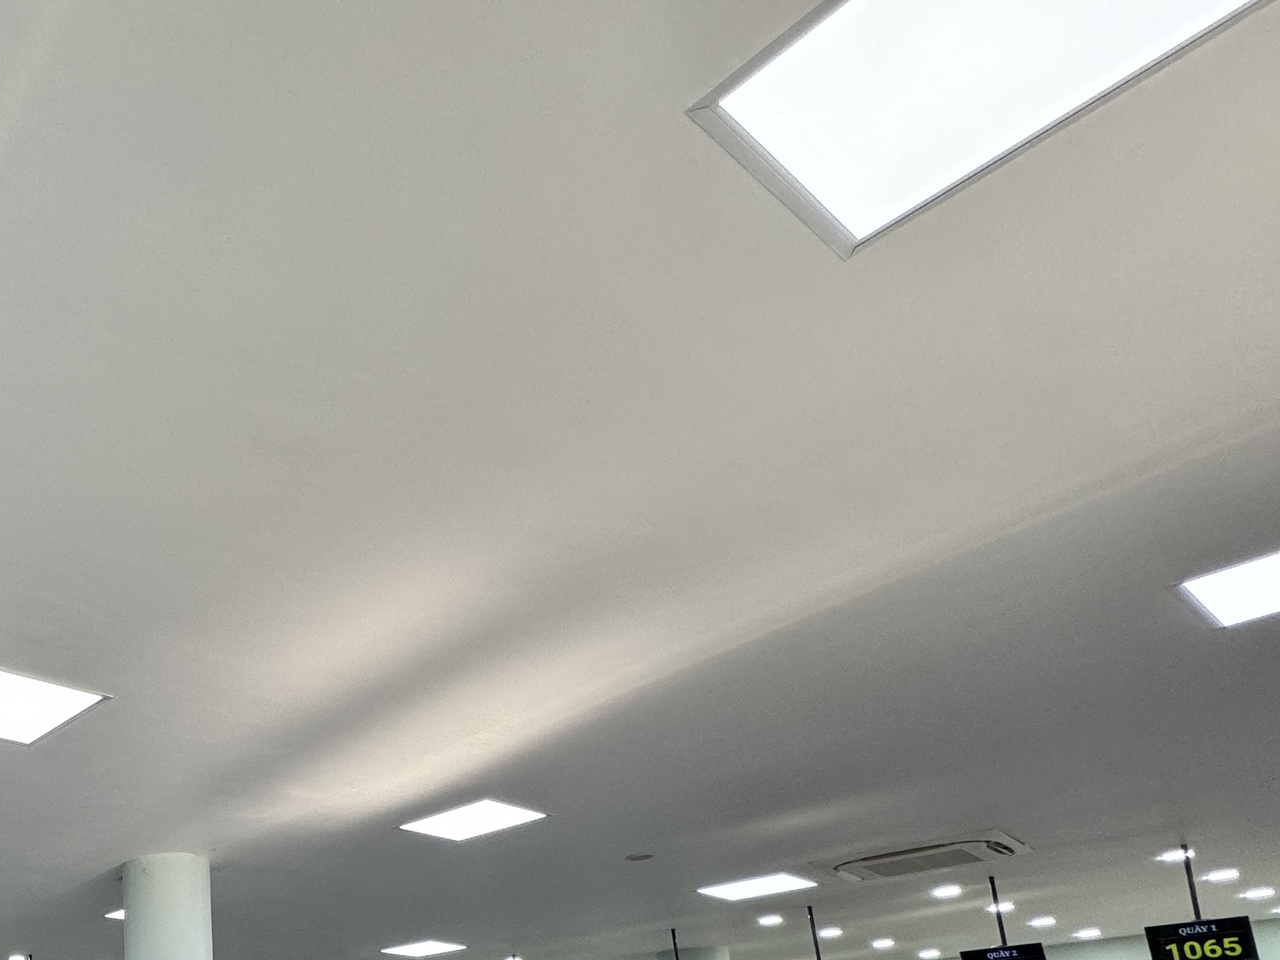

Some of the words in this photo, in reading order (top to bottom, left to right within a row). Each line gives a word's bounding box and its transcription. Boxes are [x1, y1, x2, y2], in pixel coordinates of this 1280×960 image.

[1178, 924, 1209, 936] QUẦY
[1210, 924, 1218, 932] 1
[986, 950, 1011, 960] QUẦY
